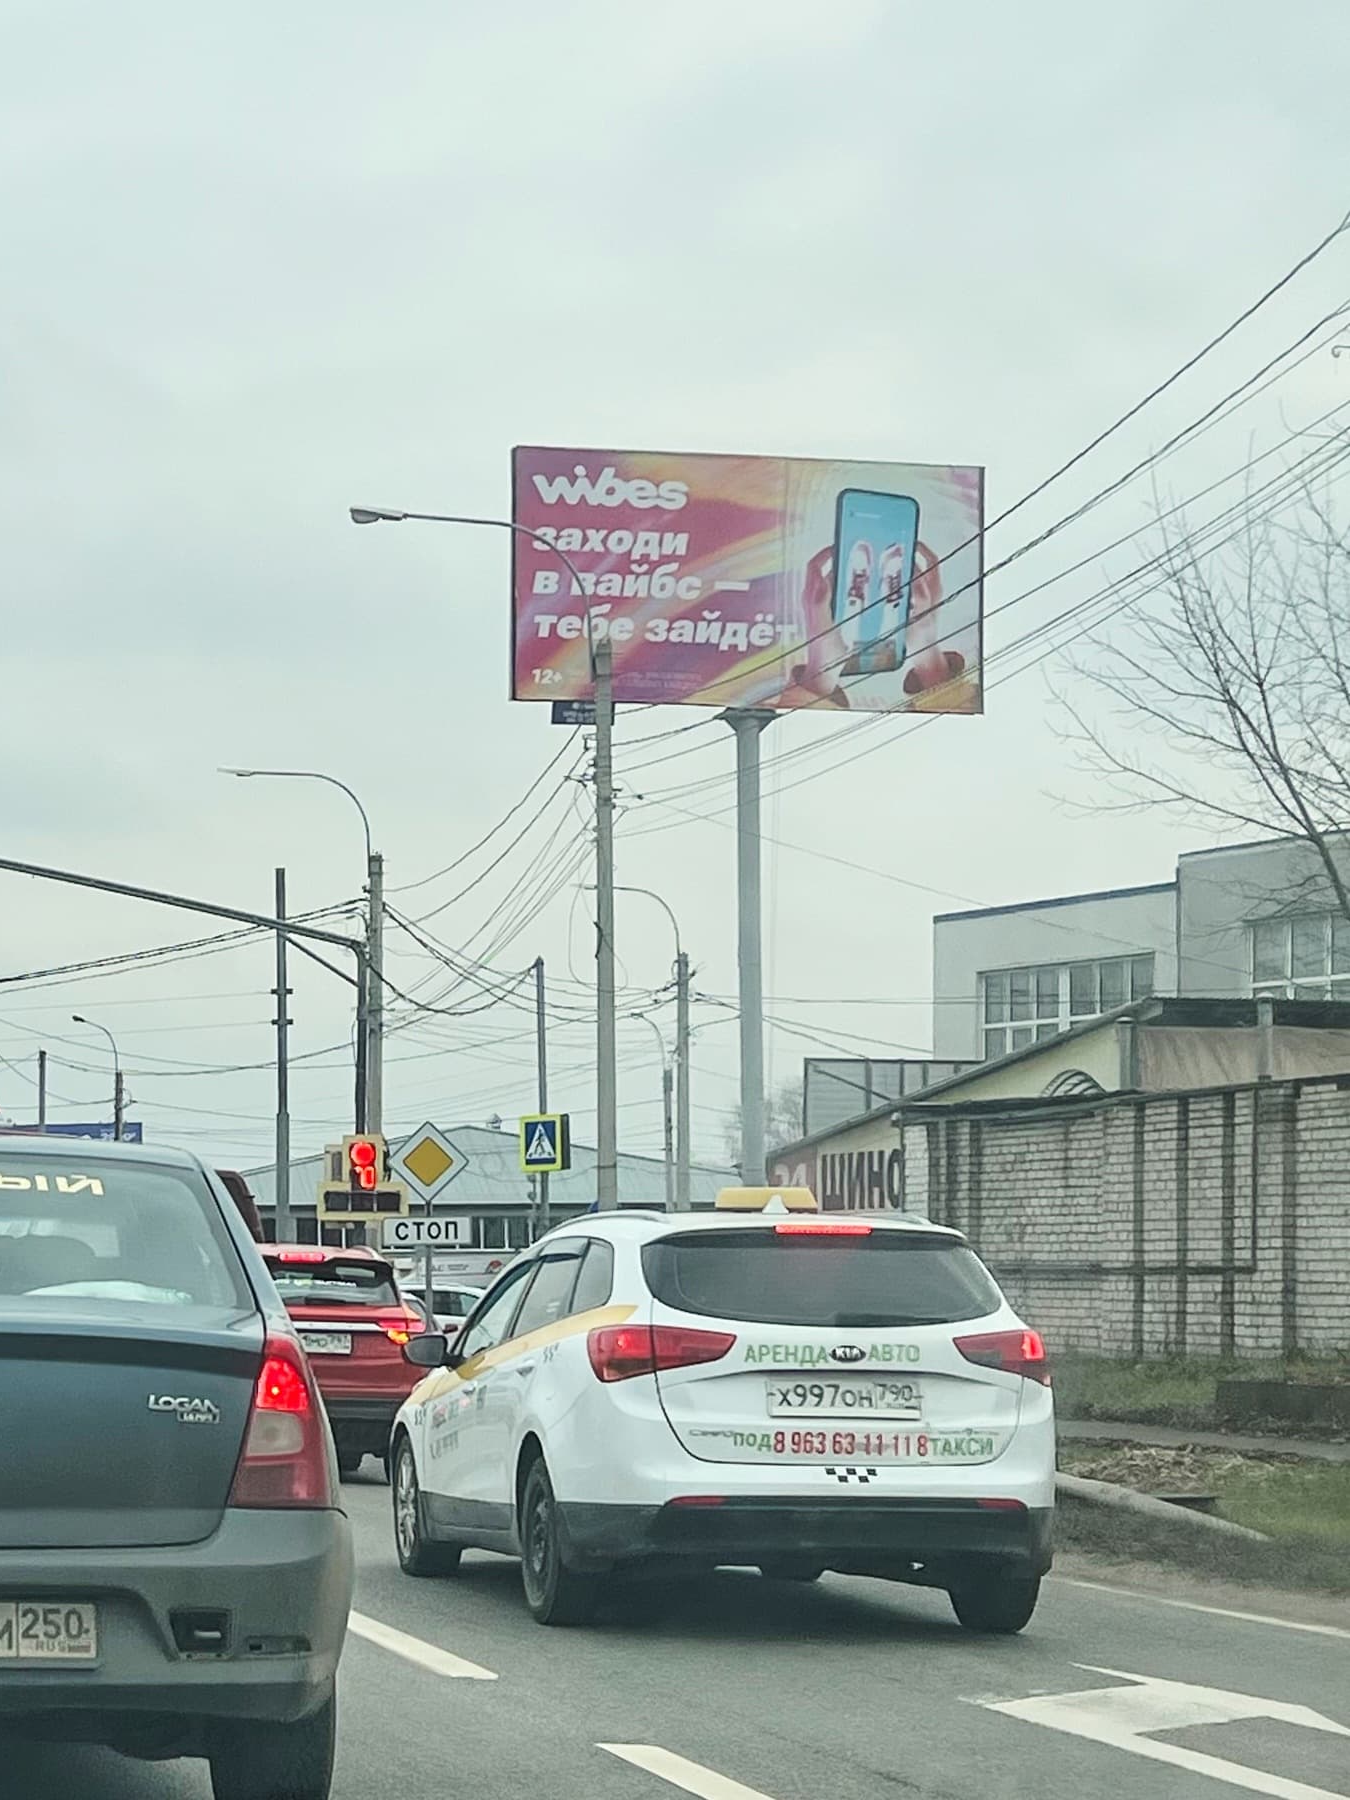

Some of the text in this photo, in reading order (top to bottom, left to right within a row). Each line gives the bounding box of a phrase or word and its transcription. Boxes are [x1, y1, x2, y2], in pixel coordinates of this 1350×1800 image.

[531, 464, 689, 511] wibes
[531, 526, 690, 561] заходи
[532, 570, 559, 595] в
[570, 562, 702, 600] вайбс
[533, 603, 799, 652] тебе зайдёт
[531, 668, 564, 685] 12+
[394, 1221, 459, 1241] СТОП
[744, 1344, 921, 1368] АРЕНДА АВТО
[148, 1393, 219, 1413] LOGAN
[930, 1437, 995, 1457] ТАКСИ
